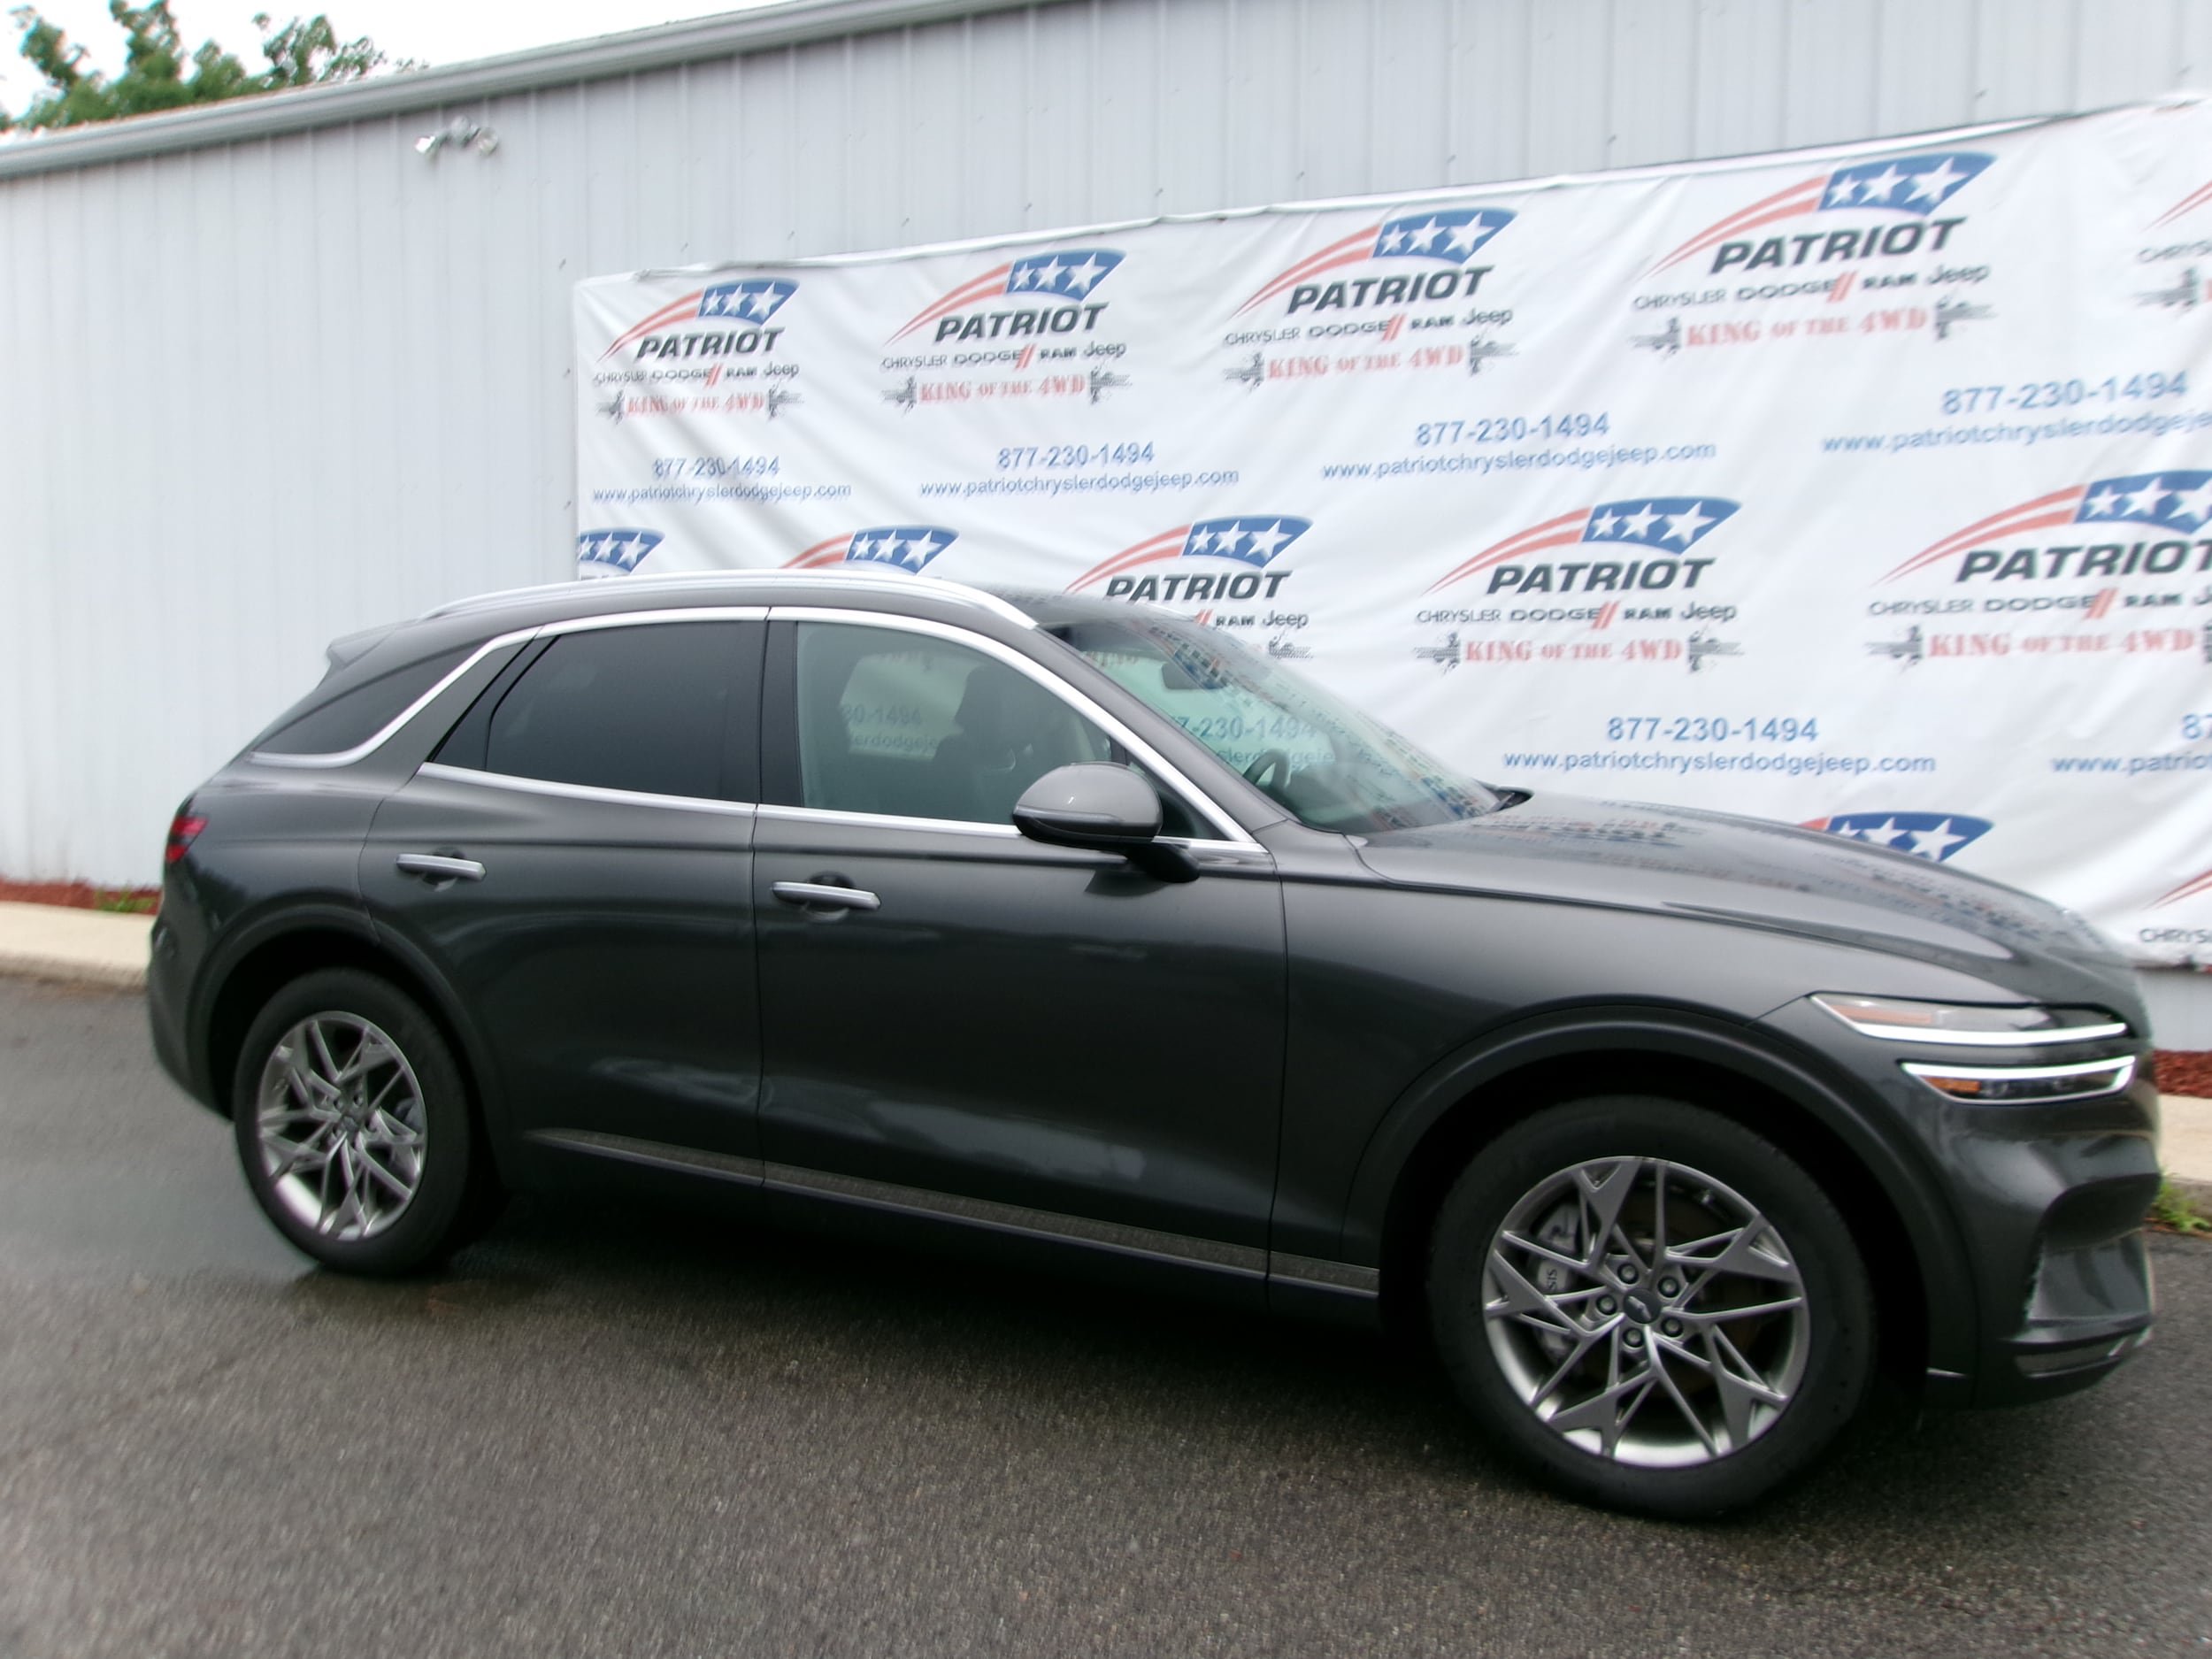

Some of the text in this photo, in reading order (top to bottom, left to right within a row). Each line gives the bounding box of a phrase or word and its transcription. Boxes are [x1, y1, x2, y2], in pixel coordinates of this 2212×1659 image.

[1709, 217, 1967, 274] PATRIOT
[1286, 265, 1495, 313] PATRIOT
[1633, 265, 1991, 310] CHRYSLER DODGE RAM Jeep
[934, 302, 1109, 342] PATRIOT
[1225, 308, 1513, 345] CHRYSLER DODGE RAM Jeep
[1686, 307, 1928, 346] KING OF THE 4WD
[634, 326, 785, 361] PATRIOT
[881, 341, 1126, 370] CHRYSLER DODGE RAM Jeep
[650, 368, 712, 380] DODGE
[726, 365, 758, 378] RAM
[764, 361, 799, 378] Jeep
[1269, 345, 1463, 379] KING OF THE 4WD
[920, 374, 1086, 403] KING OF THE 4WD
[1941, 370, 2188, 416] 877-230-1494
[626, 396, 668, 415] KING
[725, 392, 764, 411] 4WD
[1415, 411, 1609, 447] 877-230-1494
[653, 456, 780, 479] 877-230-1494
[997, 442, 1155, 470] 877-230-1494
[1322, 442, 1716, 480] www.patriotchryslerdodgejeep.com
[593, 482, 852, 505] www.patriotchryslerdodgejeep.com
[920, 469, 1239, 497] www.patriotchryslerdodgejeep.com
[1104, 571, 1293, 603] PATRIOT
[1486, 557, 1716, 595] PATRIOT
[1417, 602, 1737, 624] CHRYSLER DODGE RAM Jeep
[1868, 598, 1972, 616] CHRYSLER
[1985, 595, 2094, 611] DODGE
[2124, 593, 2182, 607] RAM
[1216, 610, 1309, 629] RAM Jeep
[1466, 639, 1684, 662] KING OF THE 4WD
[1929, 629, 2195, 657] KING OF THE 4WD
[1608, 717, 1819, 742] 877-230-1494
[1503, 750, 1936, 776] www.patriotchryslerdodgejeep.com
